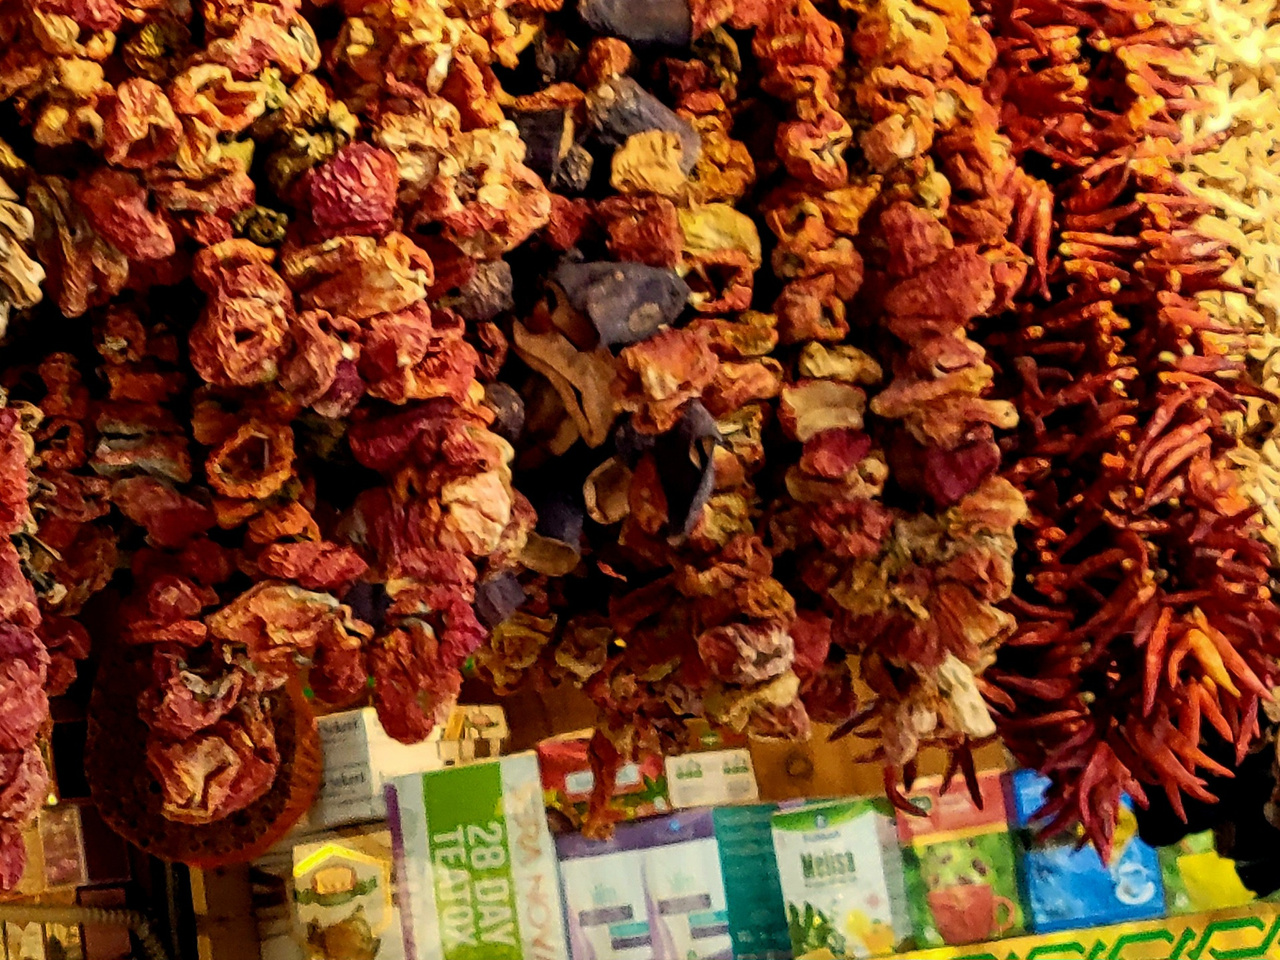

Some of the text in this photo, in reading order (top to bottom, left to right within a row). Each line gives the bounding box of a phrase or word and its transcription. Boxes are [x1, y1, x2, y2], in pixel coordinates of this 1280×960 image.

[433, 824, 478, 950] TEATOX
[466, 821, 517, 945] 28 DAY
